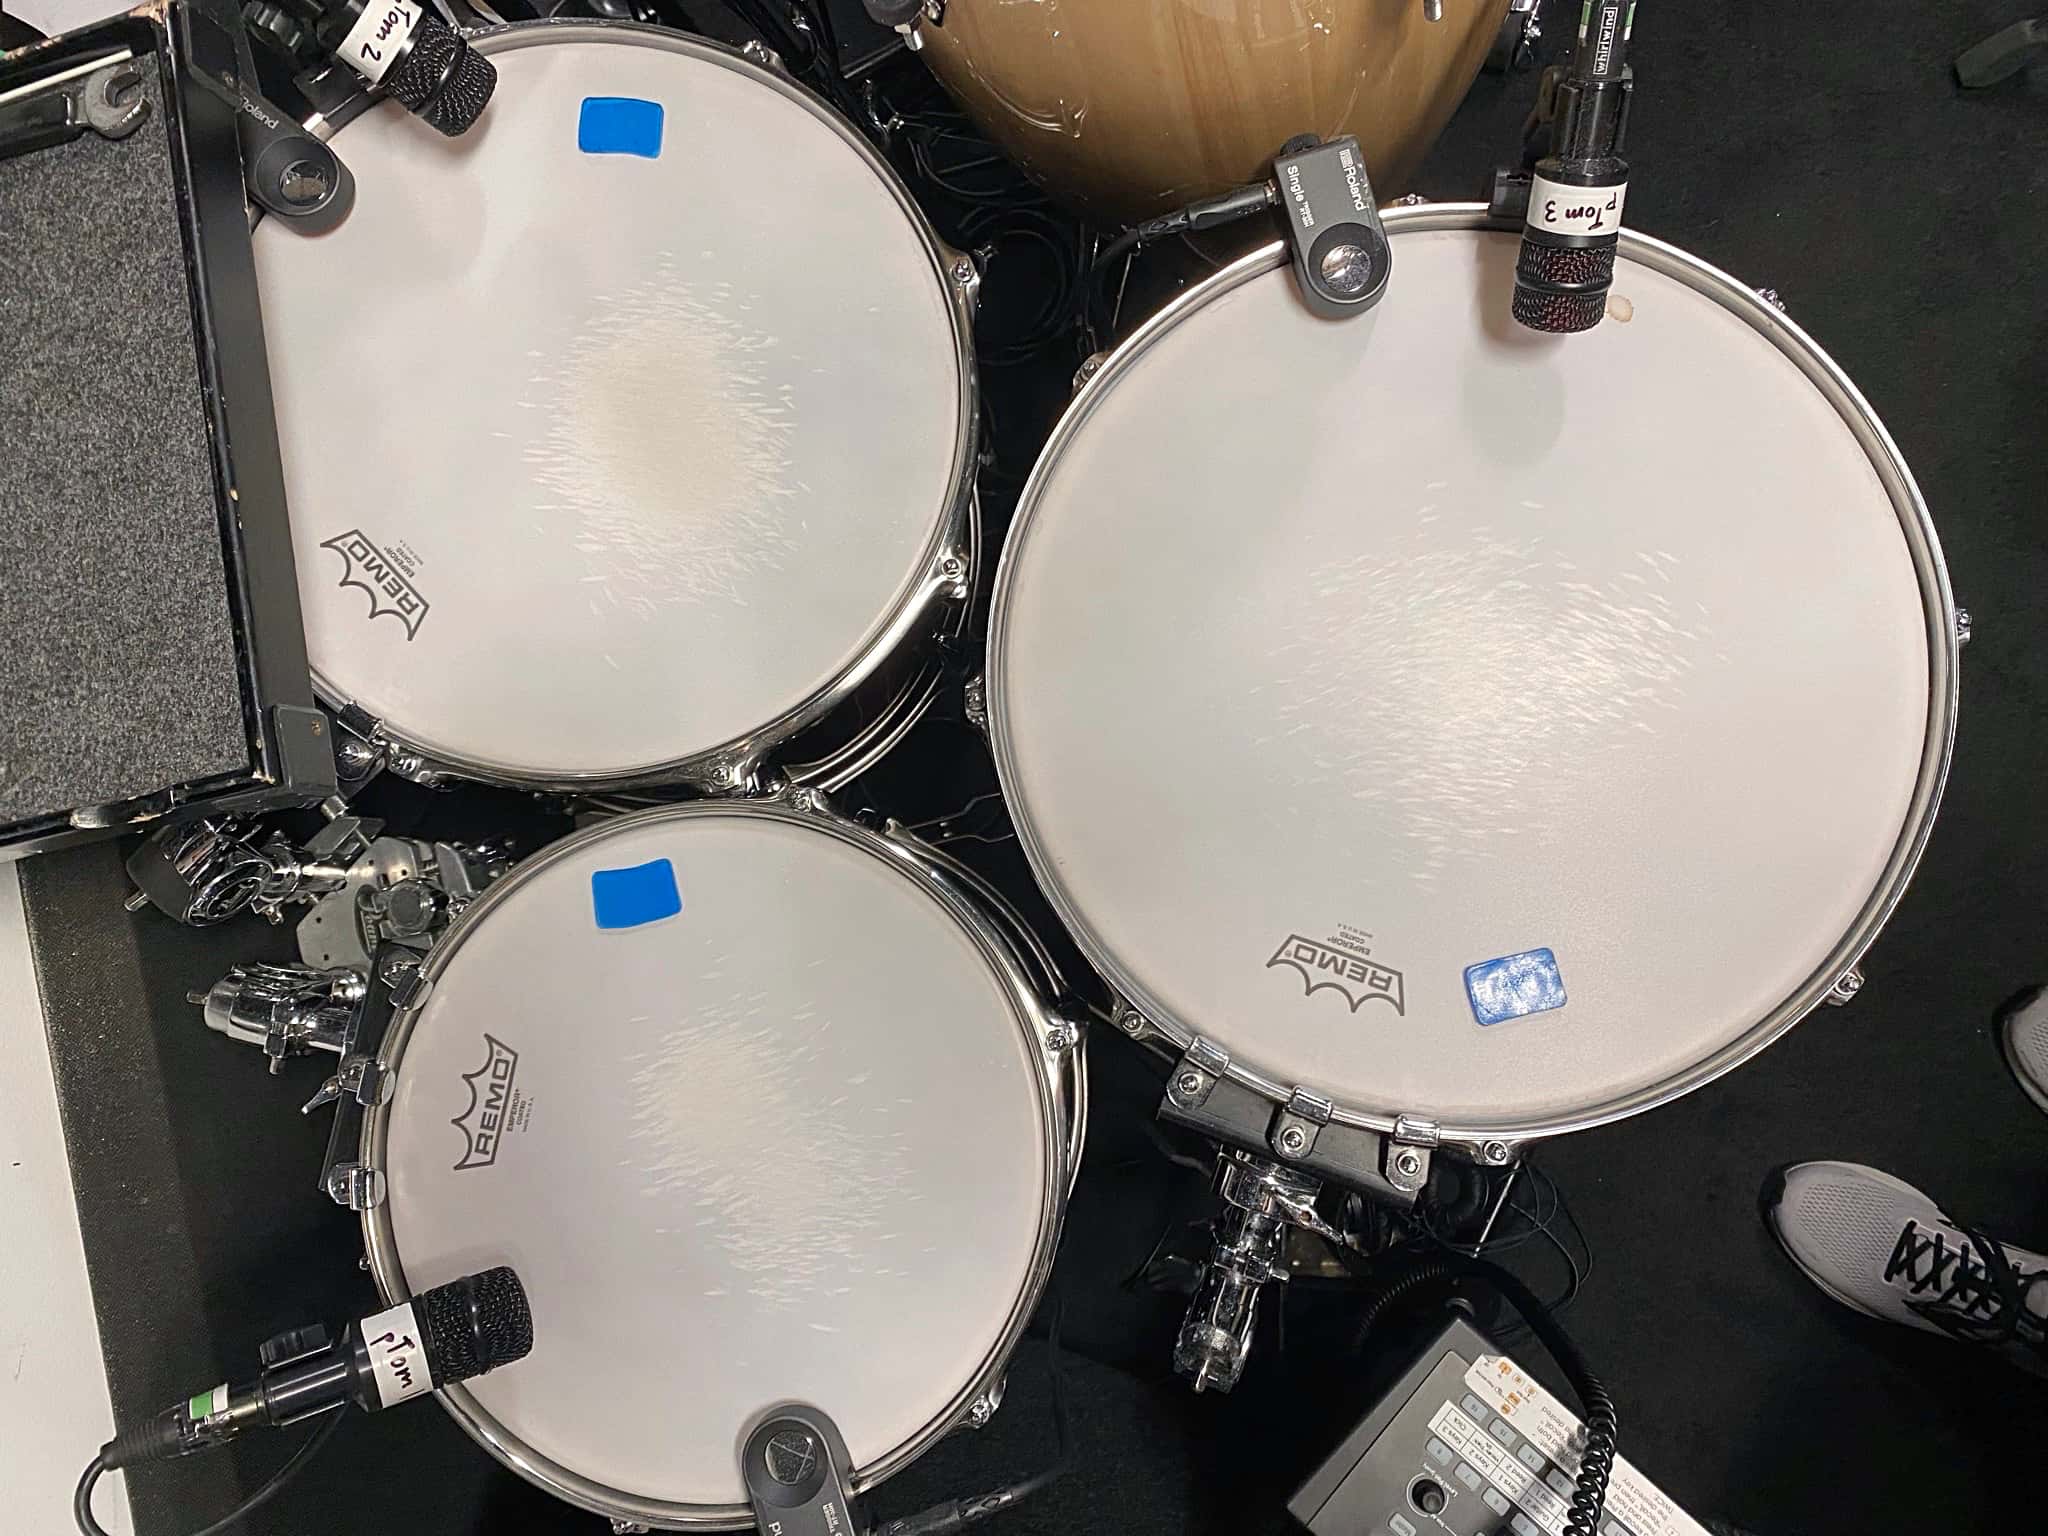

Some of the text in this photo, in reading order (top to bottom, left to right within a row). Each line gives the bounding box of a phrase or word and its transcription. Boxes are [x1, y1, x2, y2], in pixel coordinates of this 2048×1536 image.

[361, 0, 411, 61] Tom 2
[1596, 9, 1617, 73] whirlwind
[1287, 165, 1304, 202] Single
[1344, 166, 1366, 211] Roland
[1544, 200, 1557, 223] 3
[347, 540, 420, 615] REMO
[1293, 943, 1393, 993] REMO
[474, 1058, 510, 1155] REMO
[1446, 1429, 1463, 1445] Keys
[1535, 1424, 1552, 1440] both
[1473, 1451, 1490, 1468] Keys
[1502, 1478, 1519, 1494] Keys
